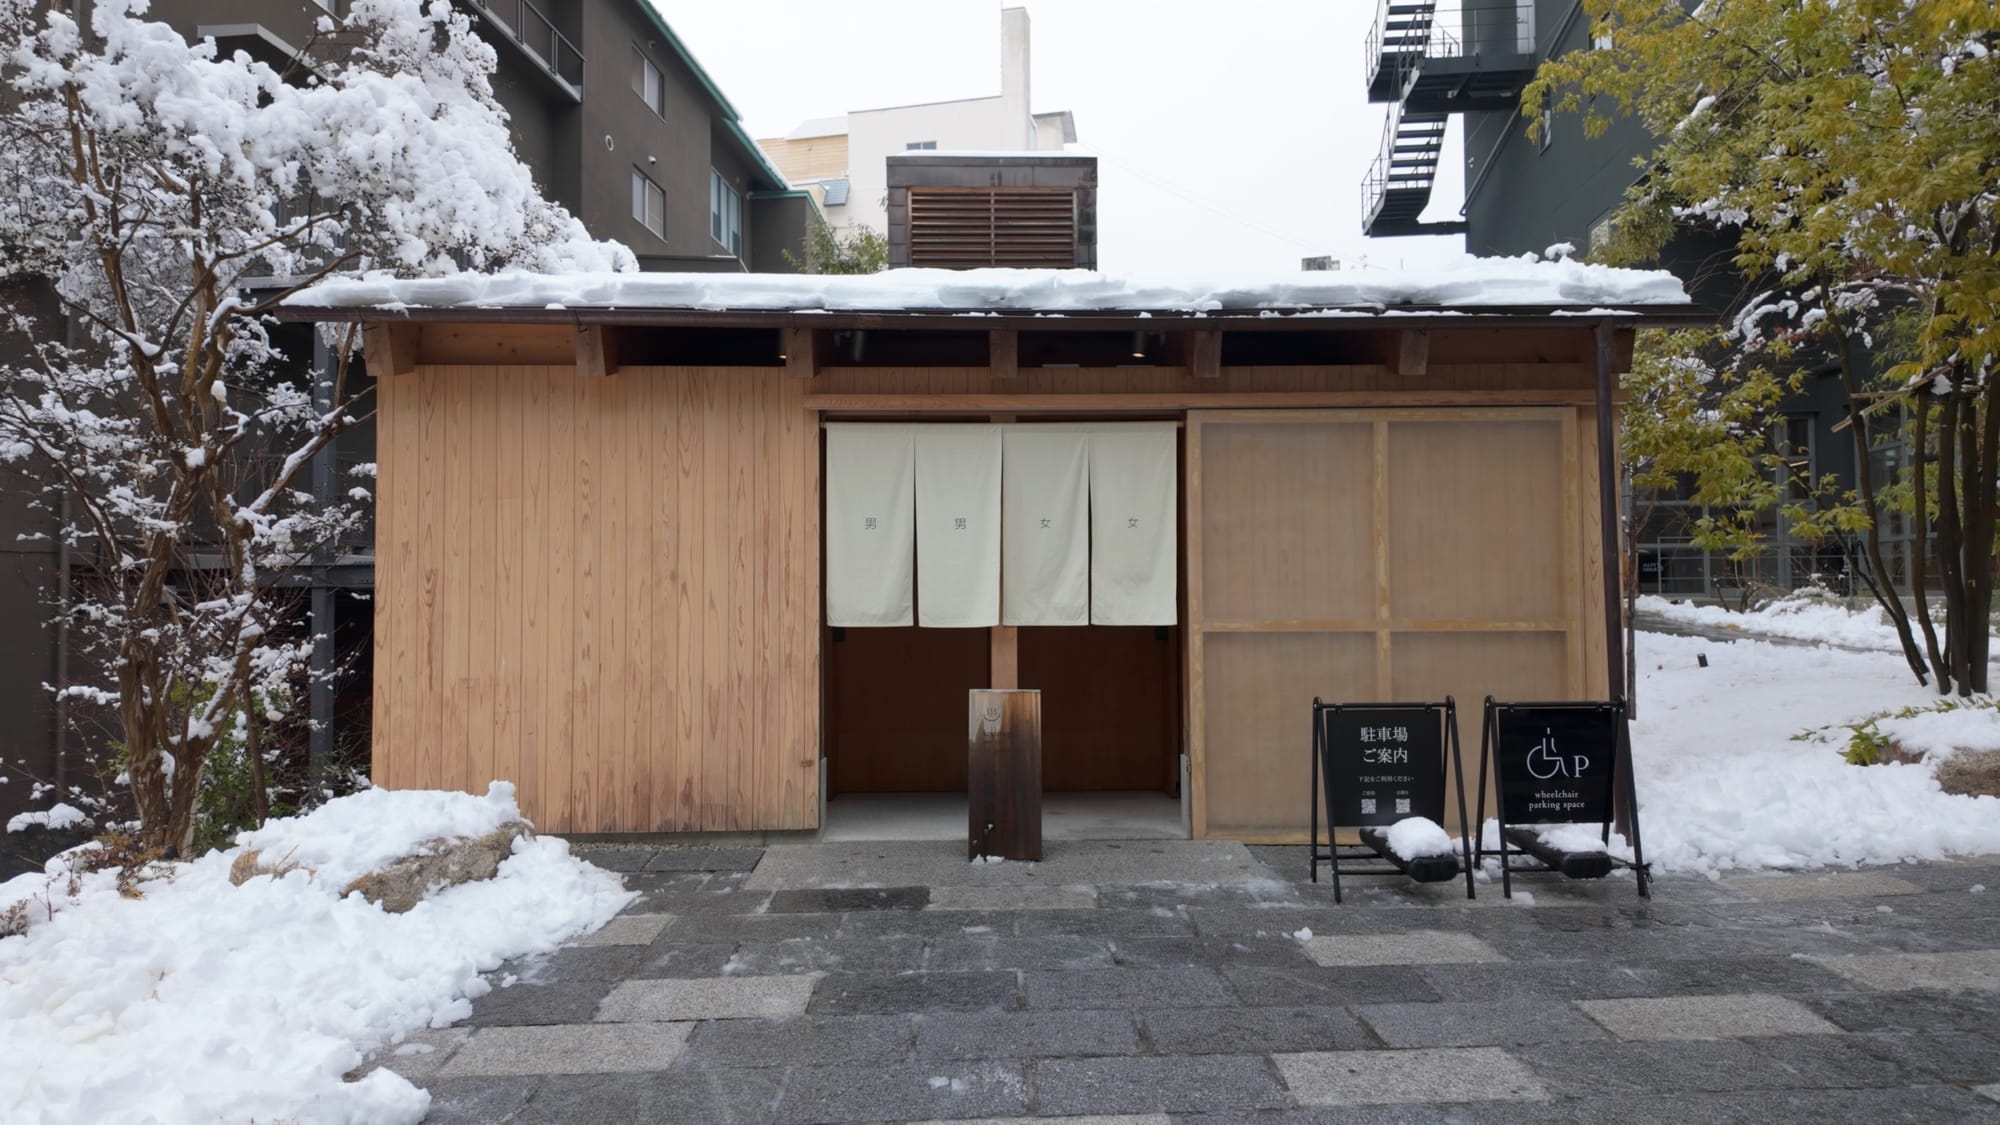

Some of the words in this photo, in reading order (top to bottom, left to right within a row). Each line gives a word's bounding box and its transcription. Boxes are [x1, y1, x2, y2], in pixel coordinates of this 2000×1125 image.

[865, 517, 877, 530] 男
[955, 517, 967, 530] 男
[1040, 517, 1051, 529] 女
[1127, 517, 1139, 529] 女
[1360, 726, 1408, 743] 駐車場
[1362, 747, 1408, 764] ご案内
[1573, 755, 1590, 778] P
[1534, 789, 1579, 799] wheelchair
[1528, 800, 1561, 812] parking
[1563, 801, 1585, 811] space
